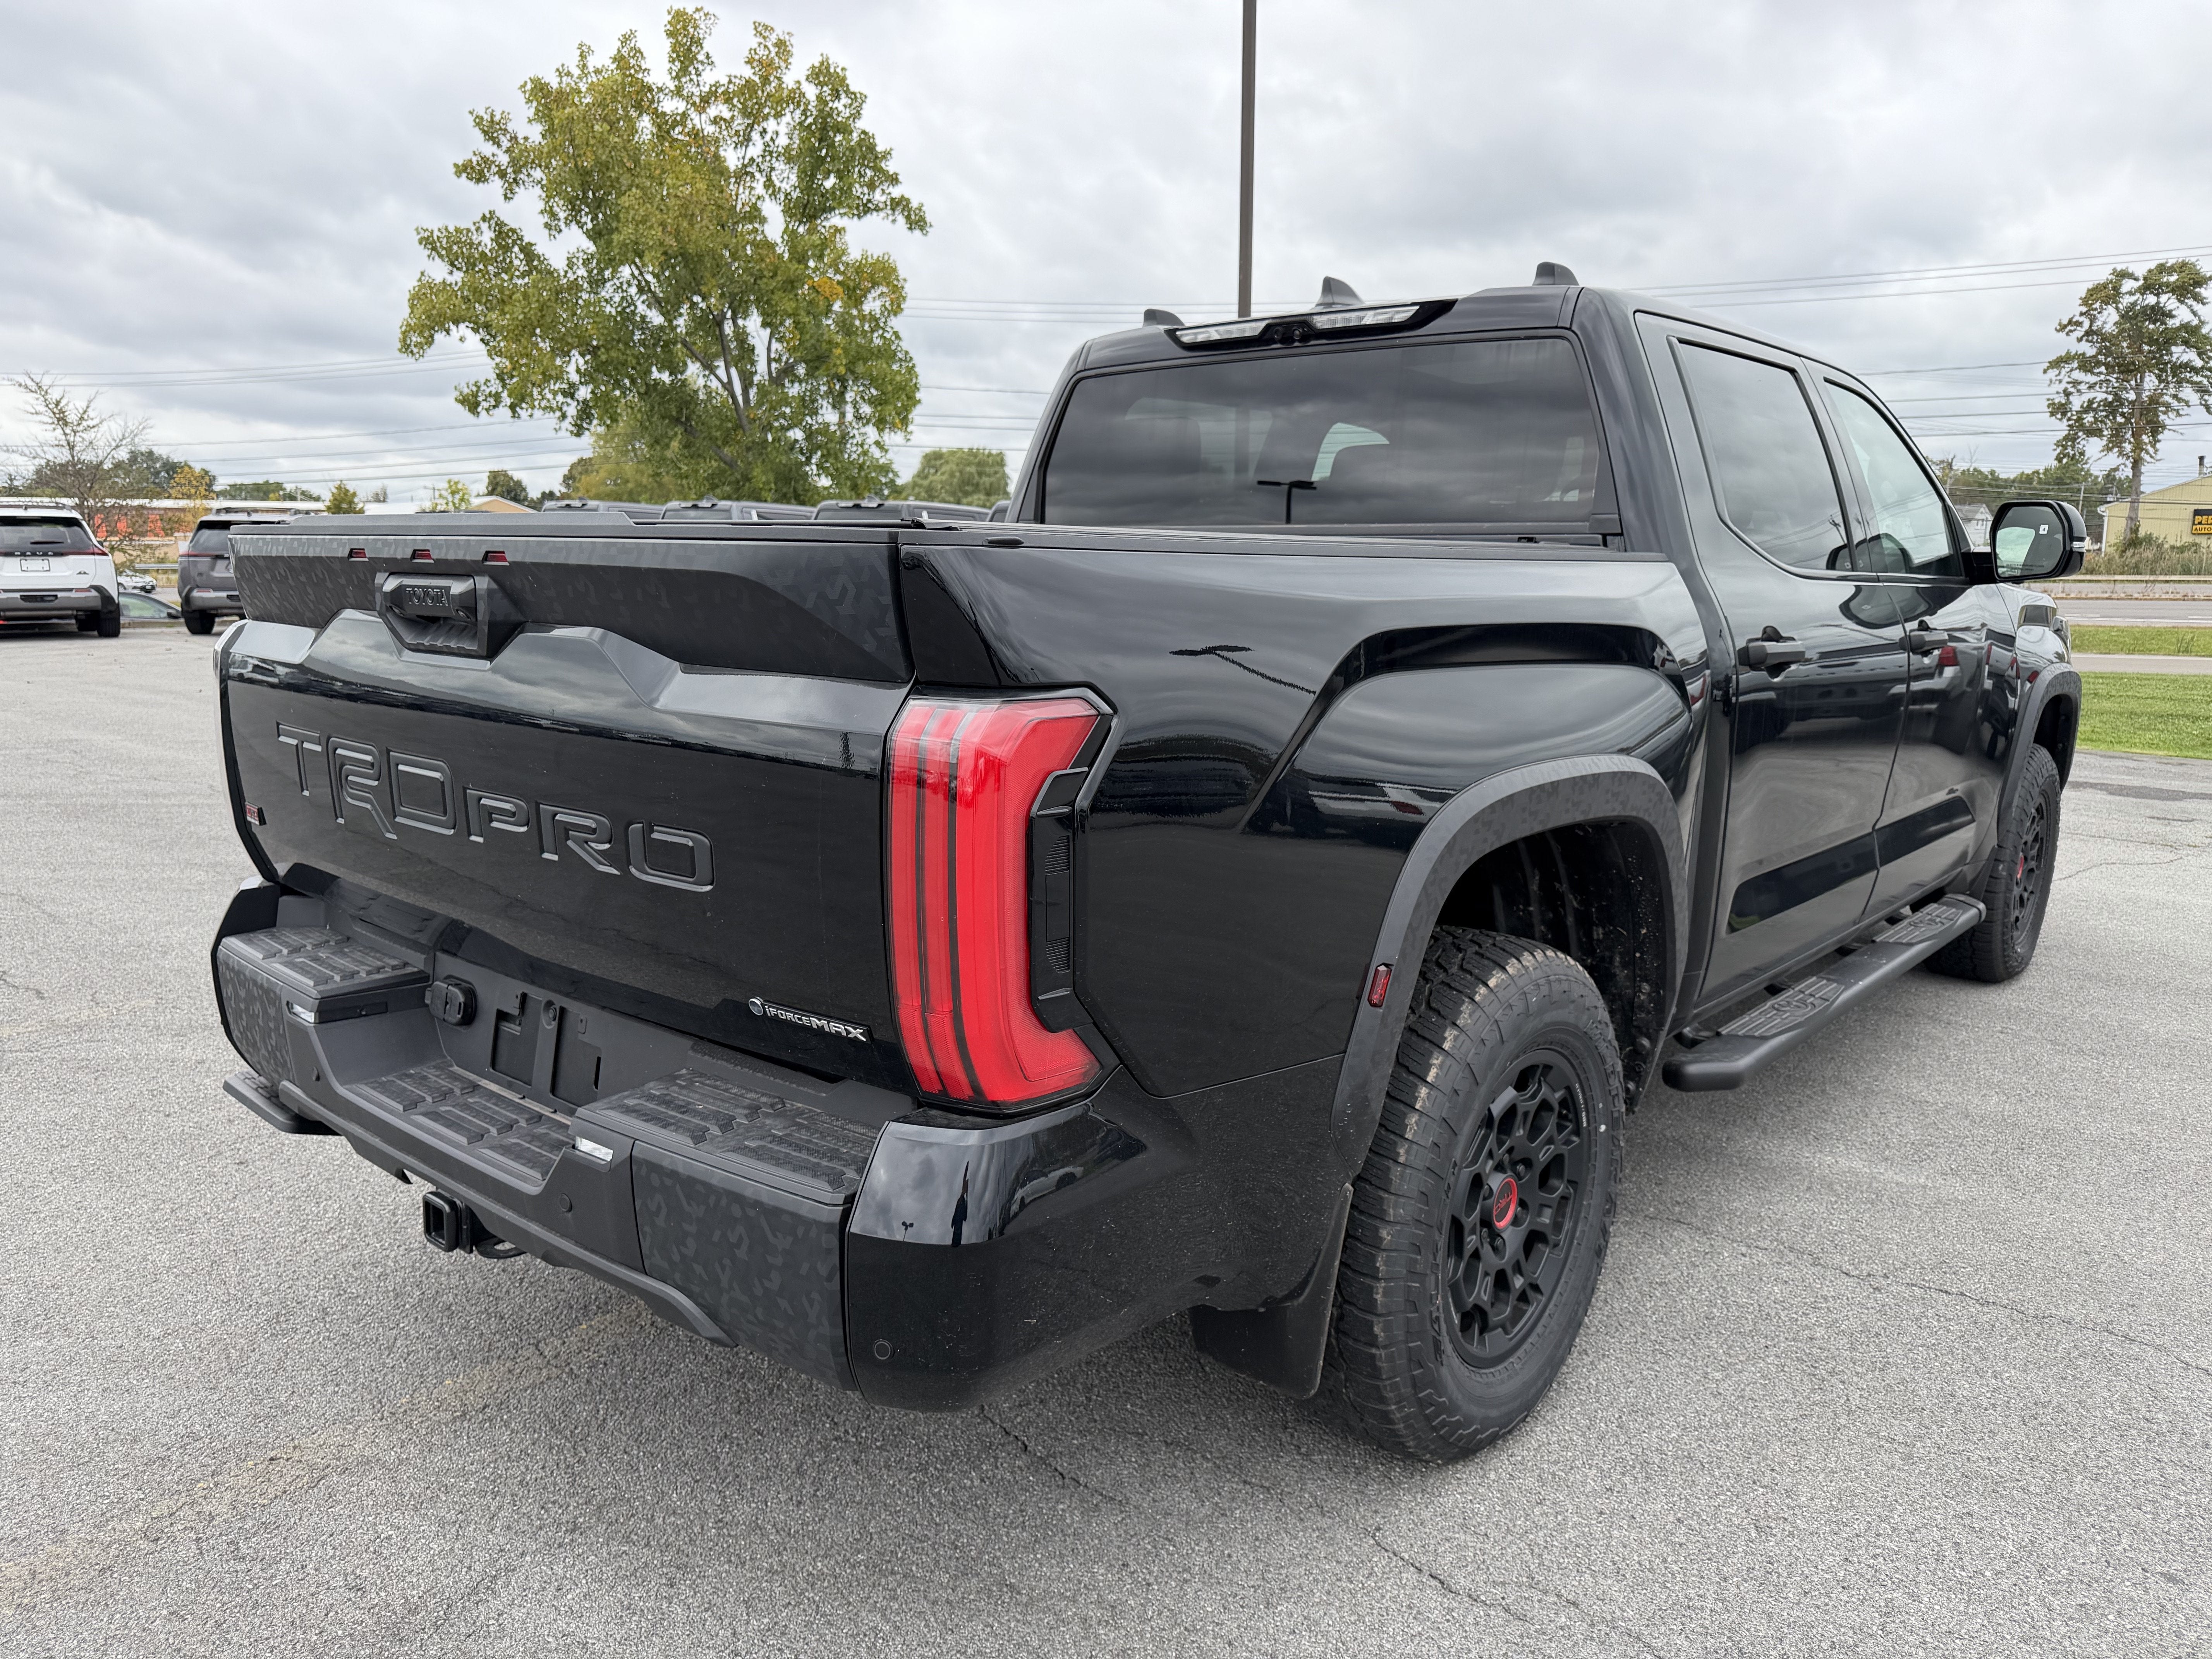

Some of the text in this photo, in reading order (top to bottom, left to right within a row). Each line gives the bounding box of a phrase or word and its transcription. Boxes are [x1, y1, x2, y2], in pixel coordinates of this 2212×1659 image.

[406, 588, 448, 606] TOYOTA
[275, 720, 715, 893] TRD PRO
